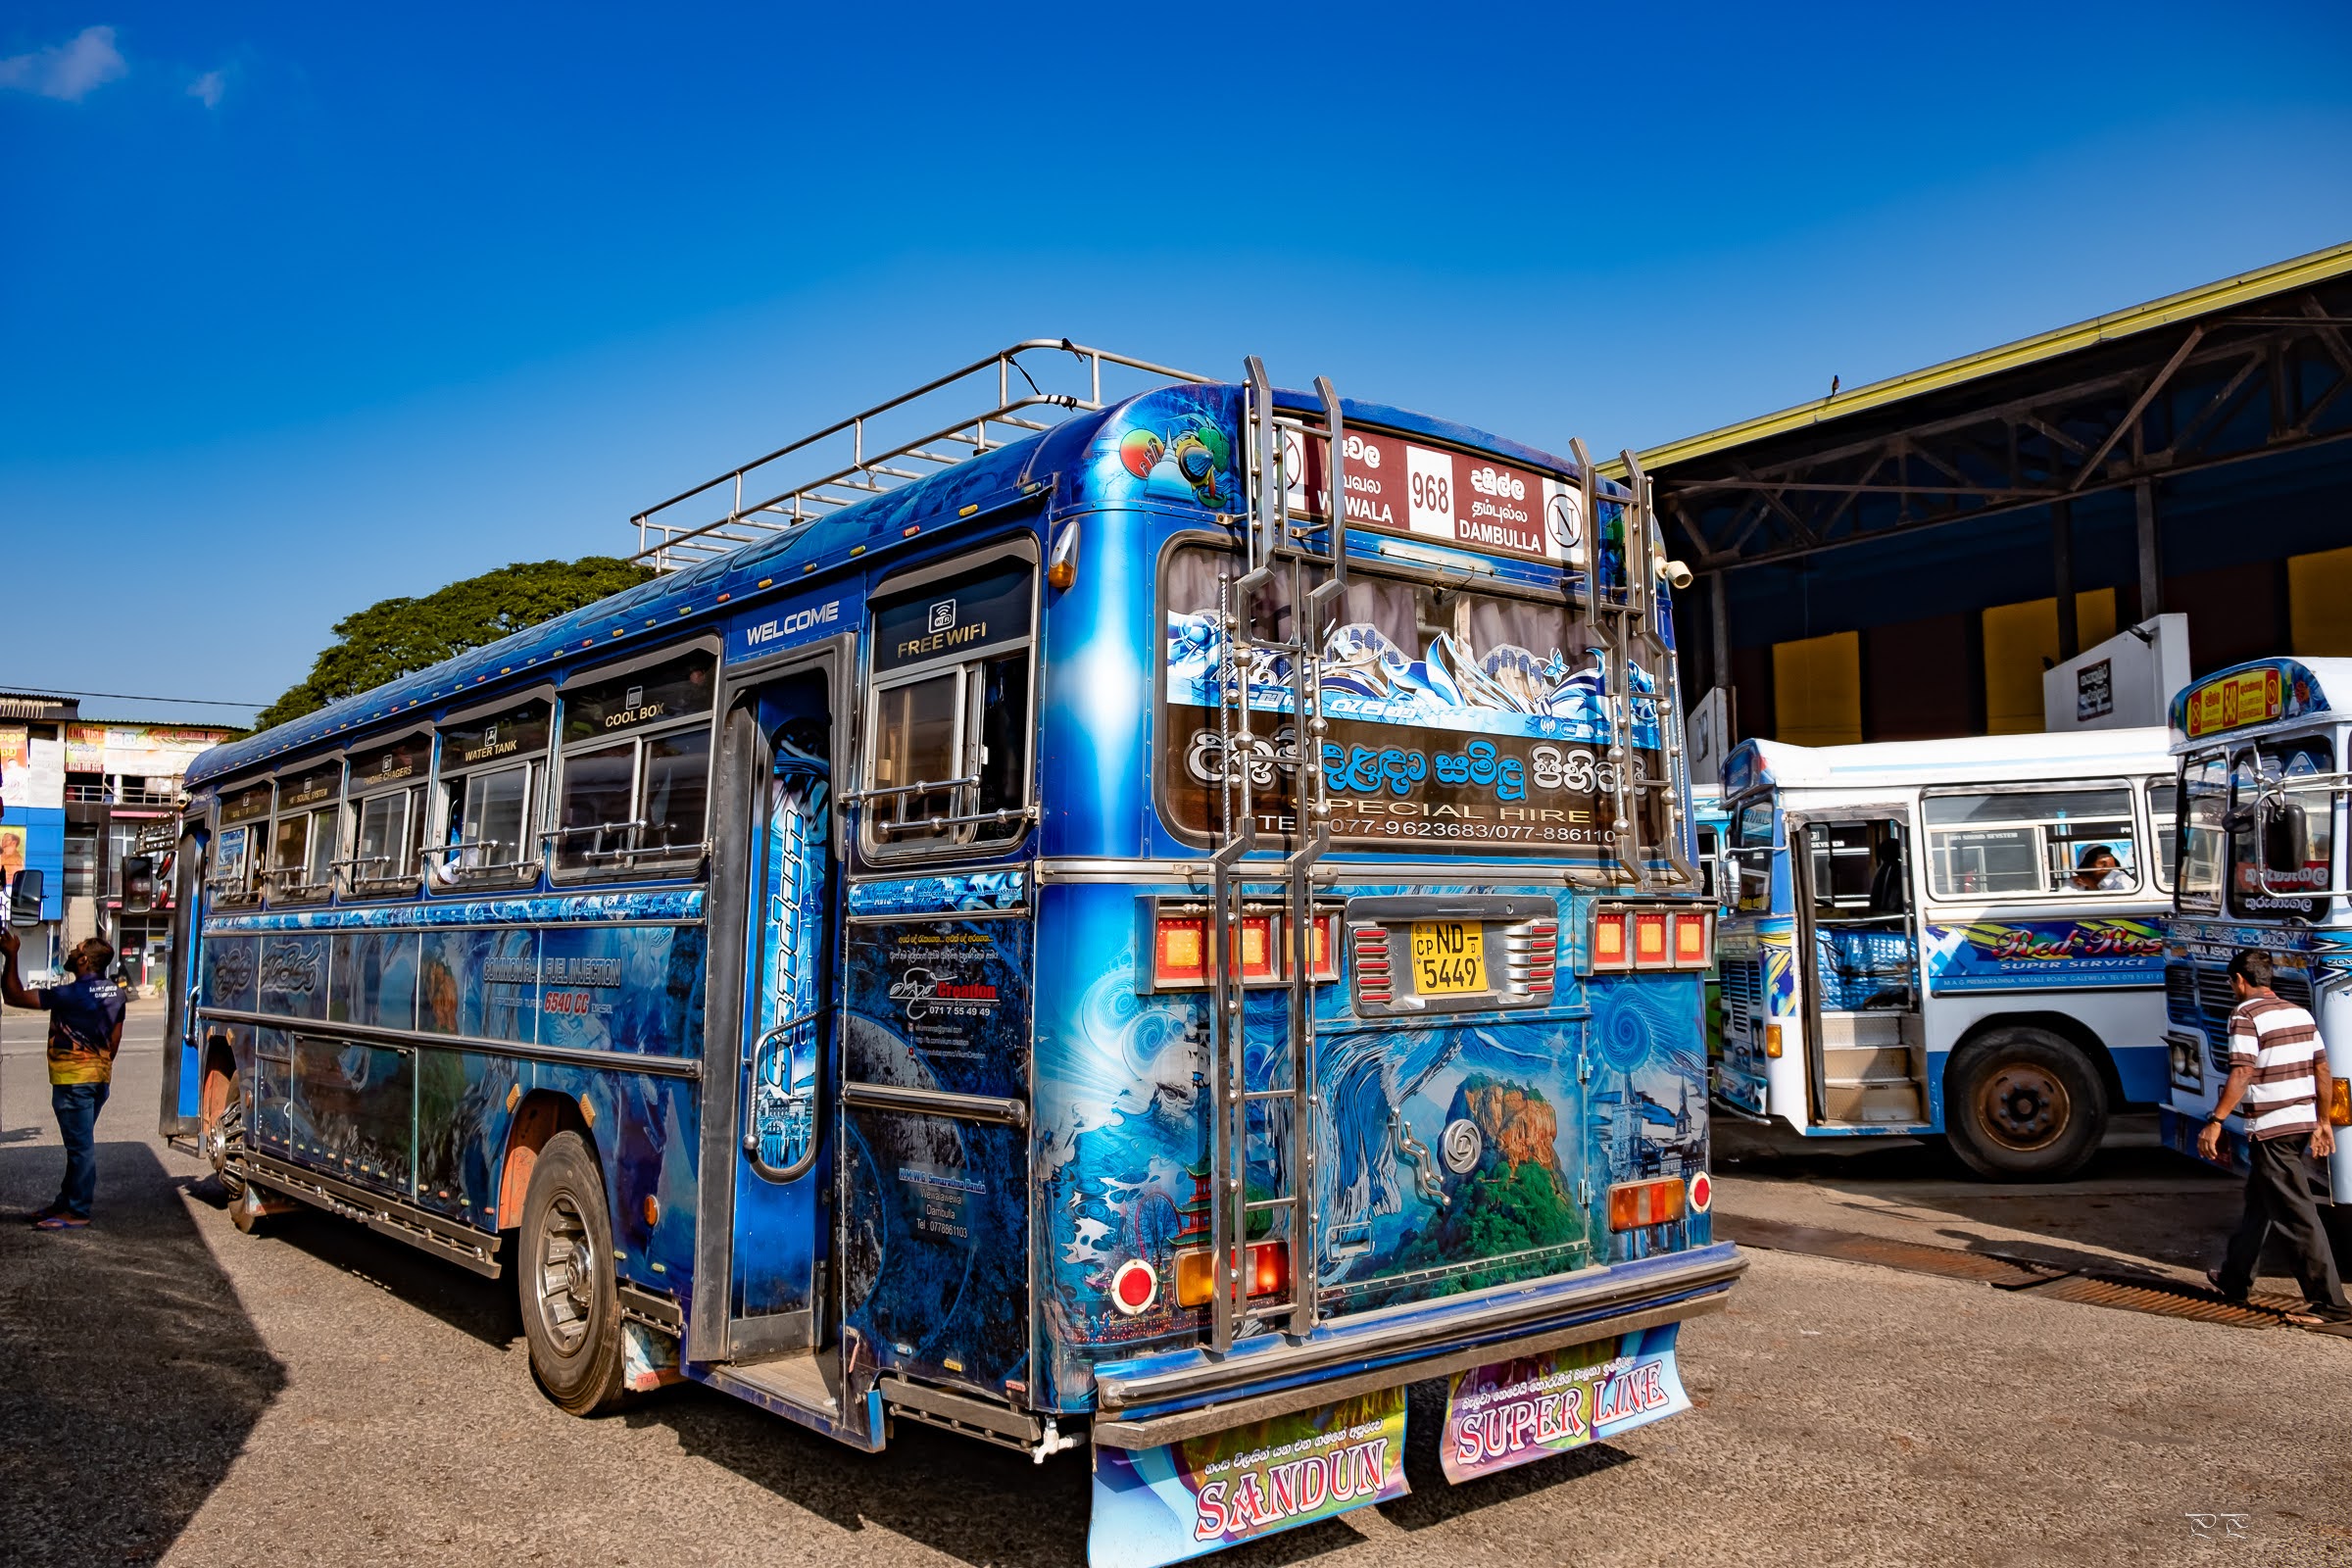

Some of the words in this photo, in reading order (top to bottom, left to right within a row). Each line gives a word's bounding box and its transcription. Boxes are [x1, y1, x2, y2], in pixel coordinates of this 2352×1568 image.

[1412, 471, 1449, 514] 968
[1317, 490, 1394, 523] WWALA
[1471, 498, 1528, 523] தம்புல்ல
[1459, 518, 1542, 553] DAMBULLA
[747, 600, 840, 646] WELCOME
[898, 633, 944, 659] FREE
[946, 621, 987, 646] WIFI
[605, 712, 637, 728] COOL
[640, 703, 664, 720] BOX
[68, 727, 104, 740] ENGLISH
[465, 746, 492, 761] WATER
[494, 740, 517, 755] TANK
[383, 765, 413, 782] CHAGERS
[1499, 808, 1592, 823] HIRE
[1258, 814, 1311, 832] TE
[1329, 817, 1616, 844] 077-9623683/077-886110
[1417, 940, 1433, 956] CP
[1992, 929, 2079, 957] Red
[2085, 926, 2163, 955] Ros
[483, 956, 523, 983] COMMON
[524, 957, 544, 983] RAL
[546, 957, 567, 985] FUEL
[568, 957, 621, 987] INJECTION
[1423, 958, 1476, 988] 5449
[2000, 961, 2061, 970] SUPER
[2069, 958, 2147, 968] SERVICE
[937, 981, 997, 999] Creation
[544, 992, 571, 1013] 6540
[573, 993, 590, 1015] CC
[979, 1007, 991, 1016] 49
[916, 1218, 926, 1230] Tel
[930, 1221, 967, 1239] 0778861103
[1456, 1388, 1587, 1465] SUPER
[1592, 1359, 1669, 1427] LINE
[1194, 1437, 1388, 1542] SANDUN
